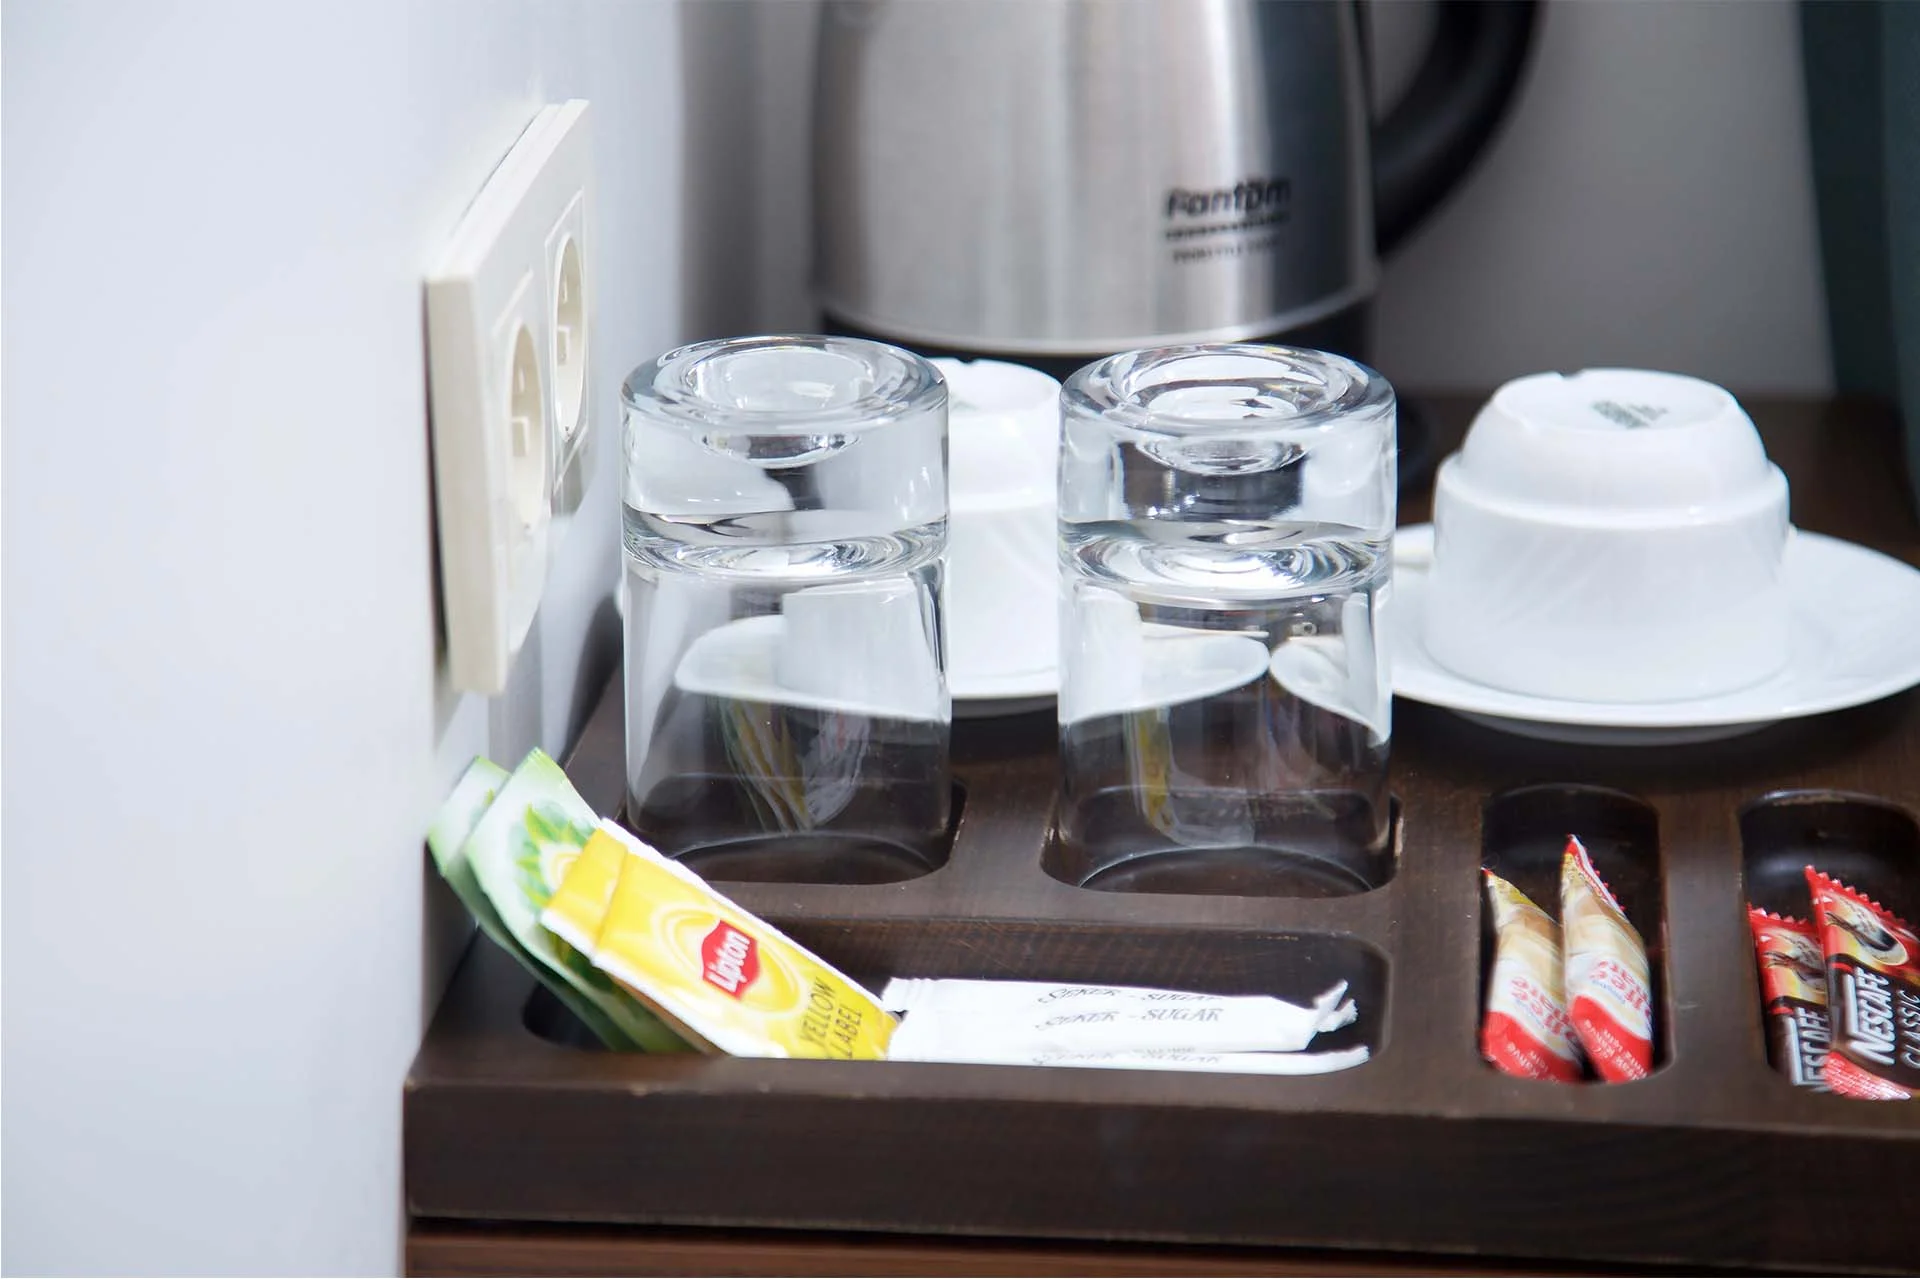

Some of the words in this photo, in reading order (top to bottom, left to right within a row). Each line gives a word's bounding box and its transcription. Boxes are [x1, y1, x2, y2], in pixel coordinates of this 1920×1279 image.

[706, 929, 750, 993] Lipton
[800, 976, 837, 1048] YELLOW
[830, 1006, 863, 1059] LABEL
[1141, 1008, 1224, 1022] SUGAR
